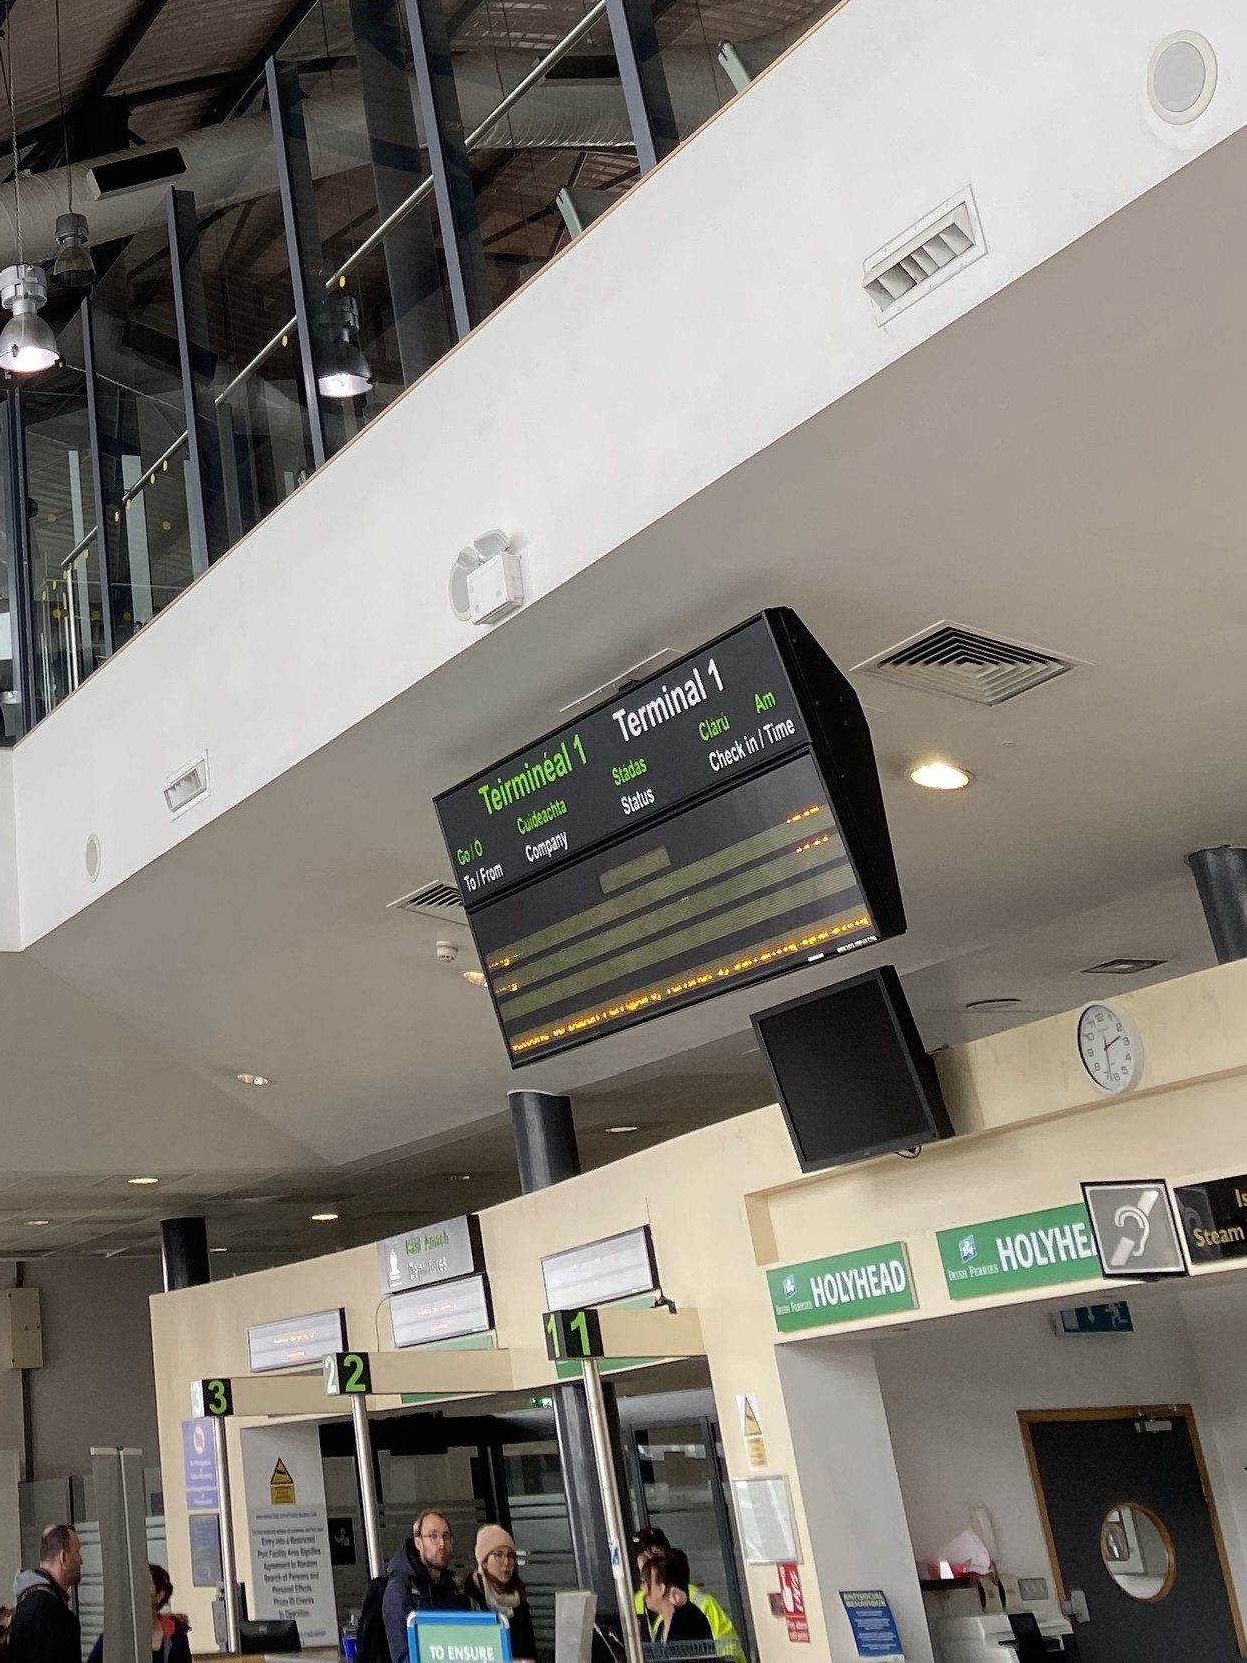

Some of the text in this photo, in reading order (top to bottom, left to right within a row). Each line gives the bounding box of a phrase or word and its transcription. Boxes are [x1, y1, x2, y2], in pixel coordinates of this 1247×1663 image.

[612, 658, 725, 742] Terminal 1
[697, 691, 777, 742] Clárú Am
[709, 718, 796, 772] Check in / Time
[478, 734, 588, 815] Teirminéal 1
[611, 756, 648, 786] Stádas
[621, 788, 656, 816] Status
[517, 800, 568, 835] Cuideachta
[457, 848, 471, 866] Go
[471, 843, 475, 860] /
[525, 831, 570, 863] Company
[463, 863, 504, 893] To / From
[1115, 1022, 1123, 1032] 2
[1123, 1036, 1130, 1046] 3
[1087, 1048, 1094, 1058] 9
[1093, 1062, 1101, 1071] 8
[1125, 1052, 1132, 1061] 4
[1113, 1072, 1121, 1082] 6
[1121, 1066, 1129, 1075] 5
[1193, 1226, 1246, 1248] Steam
[810, 1260, 906, 1308] HOLYHEAD
[947, 1264, 1000, 1281] IRISH FERRIES
[547, 1313, 561, 1358] 1
[571, 1312, 591, 1356] 1
[325, 1356, 337, 1394] 2
[343, 1354, 366, 1392] 2
[193, 1381, 202, 1415] 3
[207, 1380, 228, 1414] 3
[429, 1645, 494, 1663] TO ENSURE
